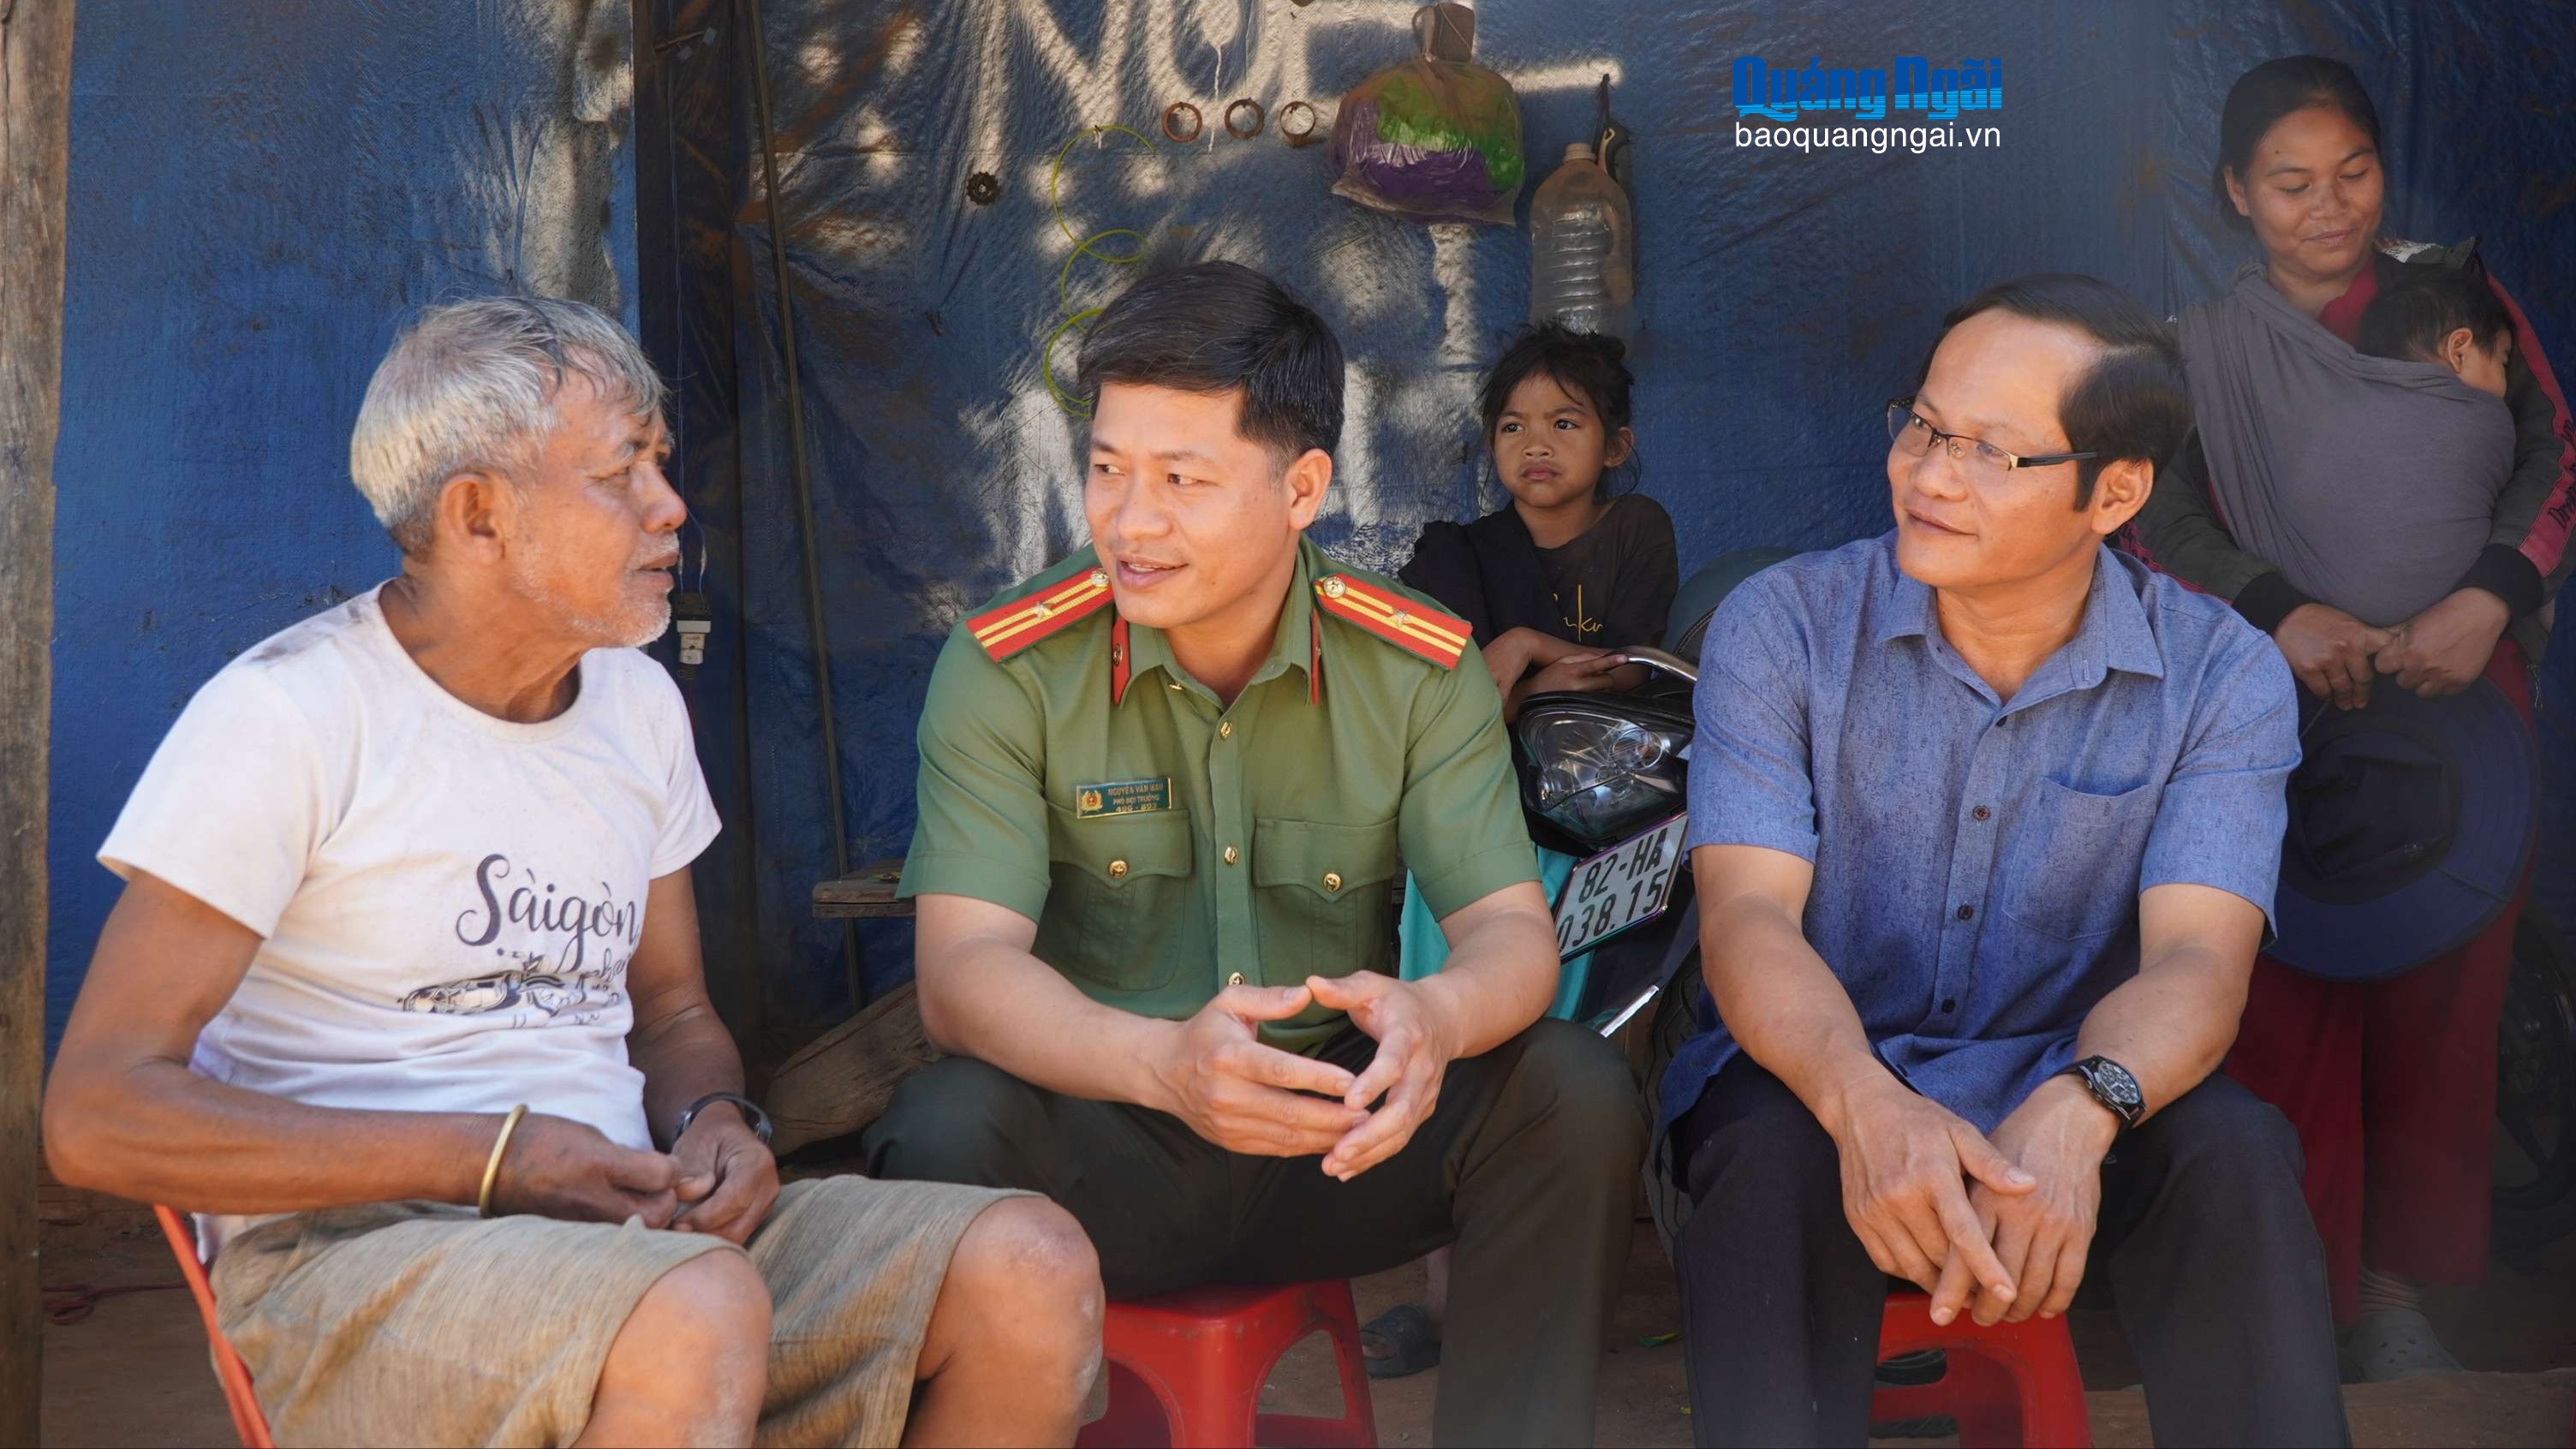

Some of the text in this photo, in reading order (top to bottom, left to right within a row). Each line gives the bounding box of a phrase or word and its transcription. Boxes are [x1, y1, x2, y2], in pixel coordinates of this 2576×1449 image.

[1578, 827, 1668, 903] 82-HA
[456, 854, 640, 972] Sàigòn
[1557, 868, 1668, 952] 038.15
